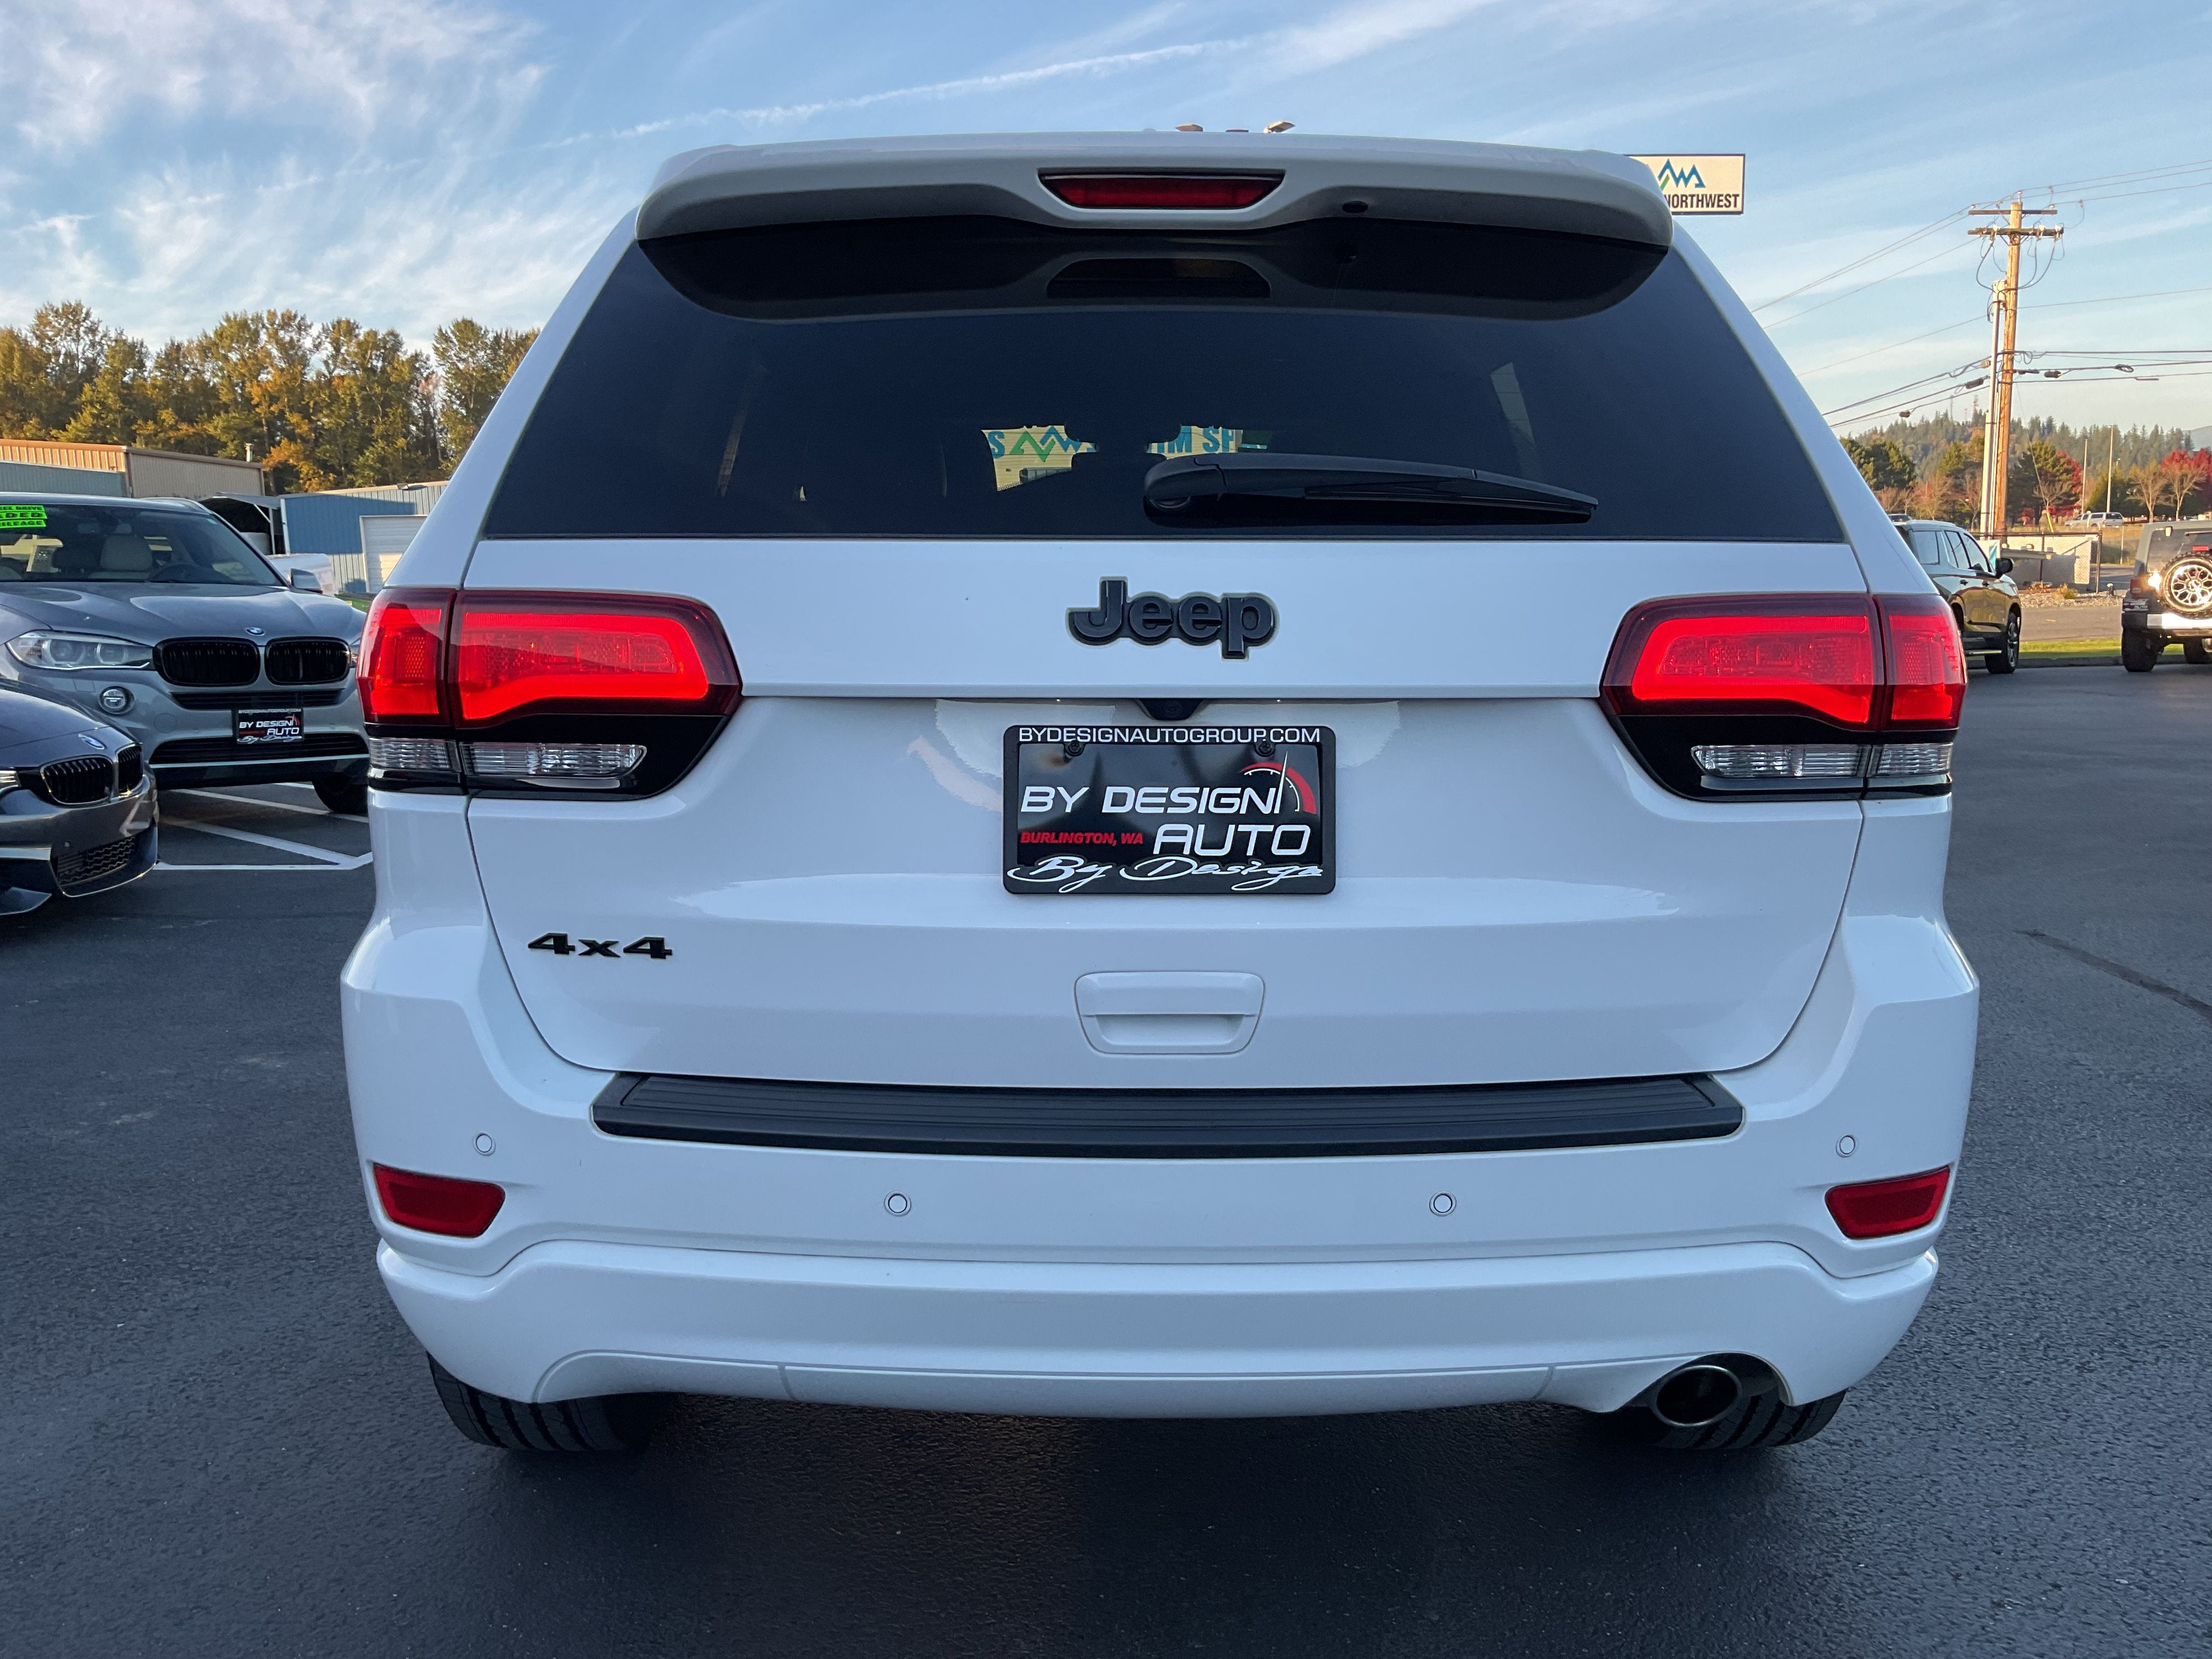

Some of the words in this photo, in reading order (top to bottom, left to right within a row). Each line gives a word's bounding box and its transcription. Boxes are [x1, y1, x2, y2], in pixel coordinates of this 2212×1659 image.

[1664, 194, 1740, 208] NORTHWEST
[1066, 577, 1280, 660] Jeep
[256, 720, 293, 728] DESIGN
[267, 727, 300, 736] AUTO
[1019, 727, 1321, 743] BYDESIGNAUTOGROUP.COM
[1020, 786, 1090, 813] BY
[1102, 786, 1277, 814] DESIGN
[1020, 832, 1118, 847] BURLINGTON,
[1120, 832, 1144, 844] WA
[1153, 823, 1311, 856] AUTO
[1007, 856, 1113, 893] By
[1119, 856, 1323, 891] Design
[527, 932, 673, 960] 4x4
